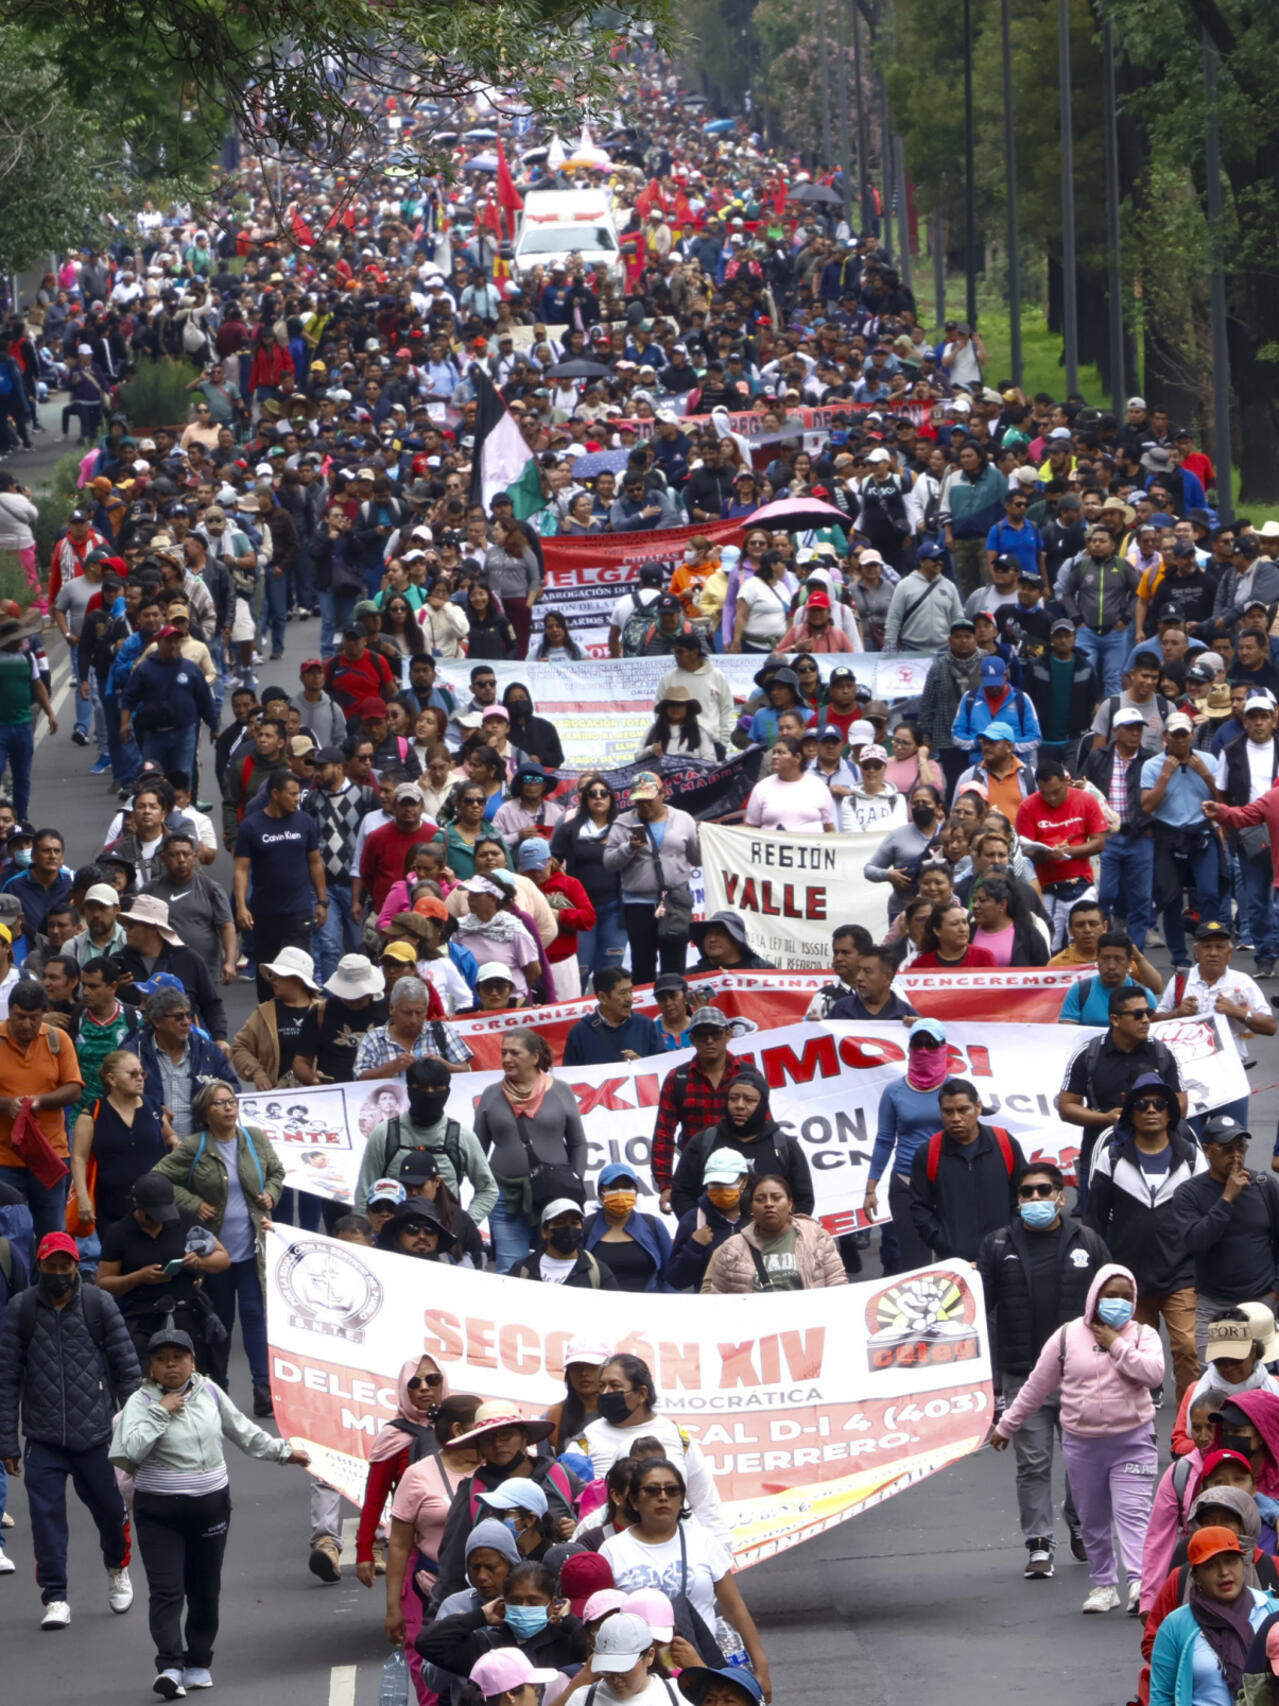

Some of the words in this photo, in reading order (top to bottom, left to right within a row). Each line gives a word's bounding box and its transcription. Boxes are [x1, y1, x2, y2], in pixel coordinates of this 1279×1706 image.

[622, 551, 679, 566] CHIAPAS
[1037, 816, 1084, 829] Champion
[262, 833, 285, 843] Calvin
[284, 830, 302, 841] Klein
[751, 842, 836, 870] REGIÓN
[721, 870, 827, 920] VALLE
[784, 938, 796, 954] DEL
[262, 1129, 342, 1145] CNTE
[1208, 1325, 1249, 1338] PORT
[424, 1307, 701, 1390] SECCÓN
[716, 1326, 827, 1389] XIV
[655, 1386, 824, 1410] EMOCRÁTICA
[842, 1412, 873, 1432] 4
[883, 1390, 988, 1430] (403)
[707, 1431, 921, 1476] UERRERO.
